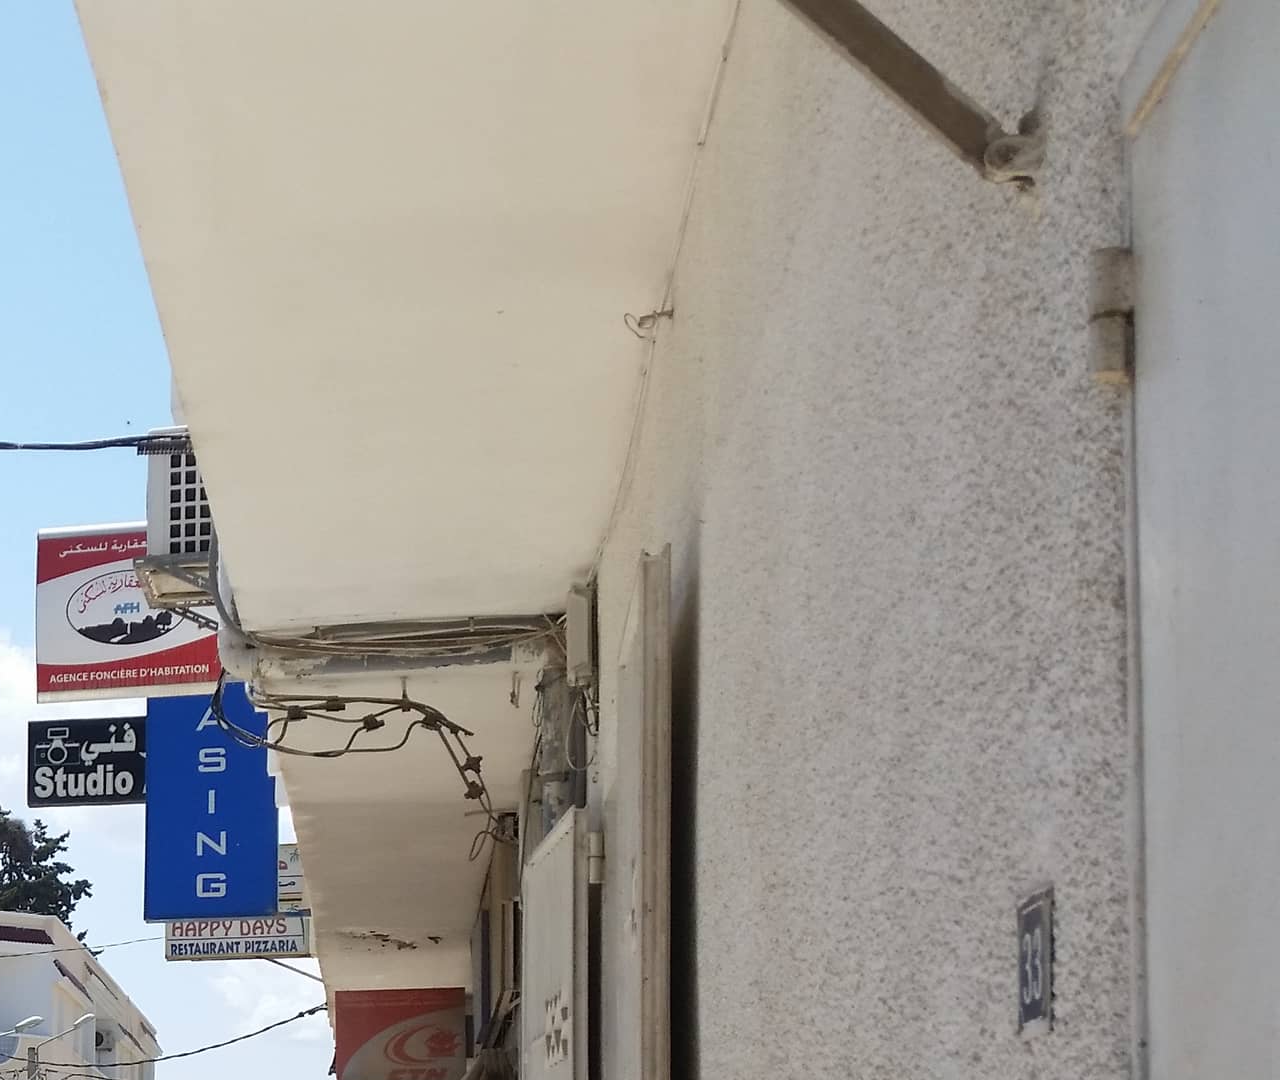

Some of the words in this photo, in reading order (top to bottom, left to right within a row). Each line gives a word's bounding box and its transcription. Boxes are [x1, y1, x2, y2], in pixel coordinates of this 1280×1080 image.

[49, 671, 88, 684] AGENCE
[90, 665, 138, 681] FONCIÈRE
[80, 721, 137, 767] فني
[34, 763, 134, 799] Studio
[171, 919, 233, 938] HAPPY
[239, 917, 288, 936] DAYS
[170, 940, 241, 957] RESTAURANT
[244, 938, 298, 953] PIZZARIA
